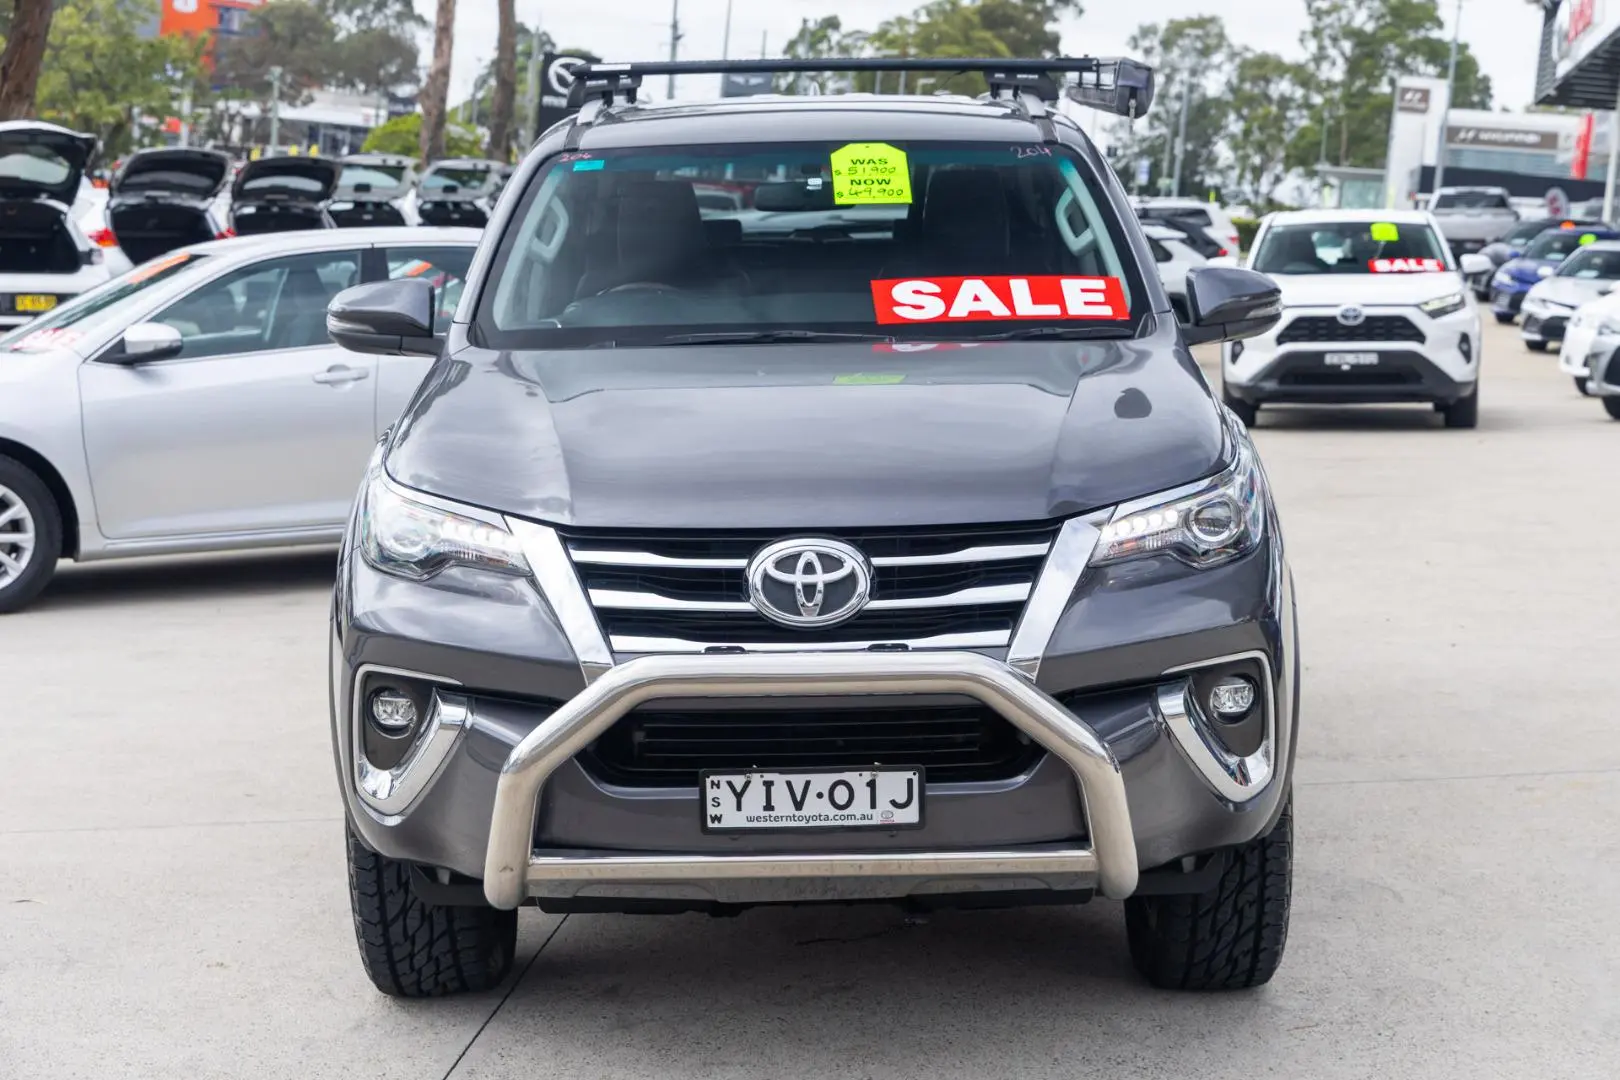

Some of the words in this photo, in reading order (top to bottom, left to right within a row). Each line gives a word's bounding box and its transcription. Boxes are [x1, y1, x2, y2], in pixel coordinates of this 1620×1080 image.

[850, 178, 891, 186] NOW
[1374, 258, 1439, 272] SALE
[890, 278, 1114, 320] SALE
[746, 812, 874, 825] westerntoyota.com.au
